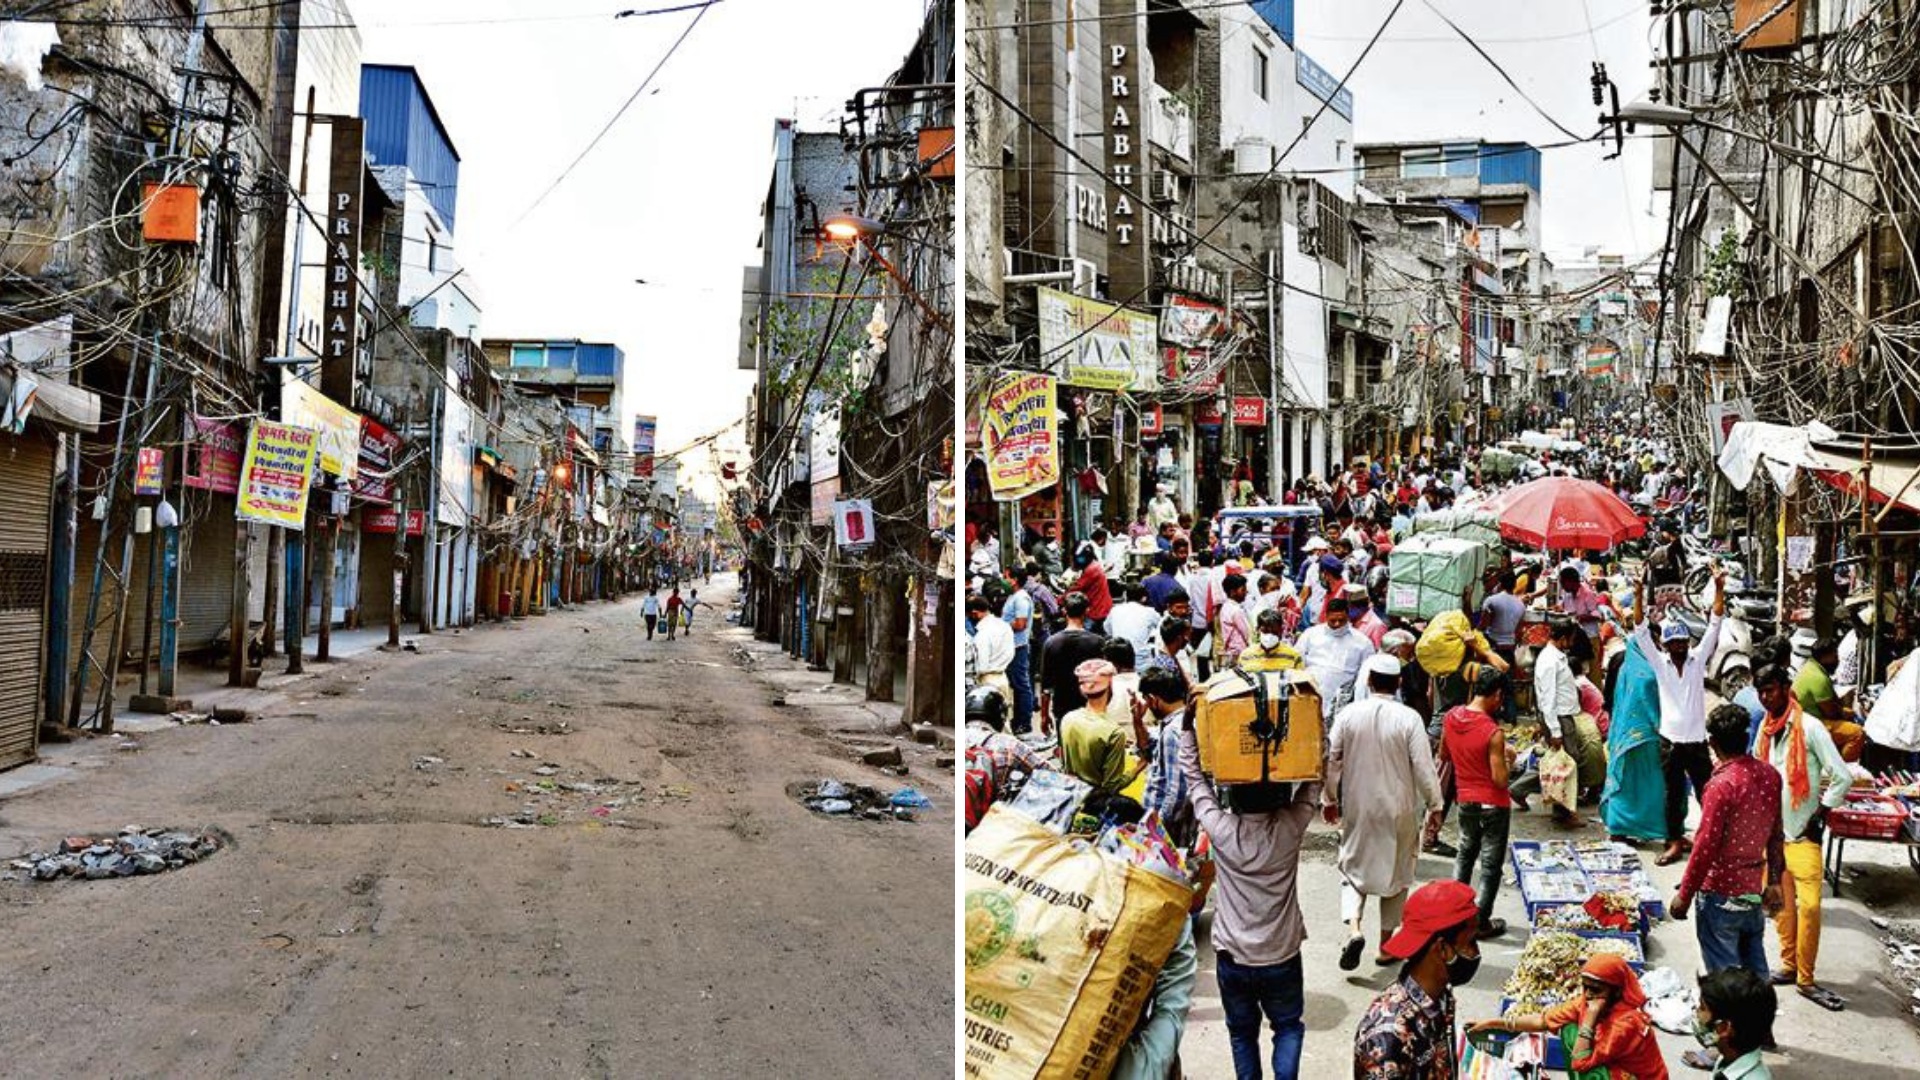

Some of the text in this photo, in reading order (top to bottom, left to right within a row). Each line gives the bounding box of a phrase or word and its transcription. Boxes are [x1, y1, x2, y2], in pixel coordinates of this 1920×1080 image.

[1110, 45, 1133, 245] PRABHAT
[1076, 184, 1108, 233] PRA
[331, 192, 351, 357] PRABHAT
[995, 866, 1018, 885] OF
[970, 994, 1009, 1020] CHAI
